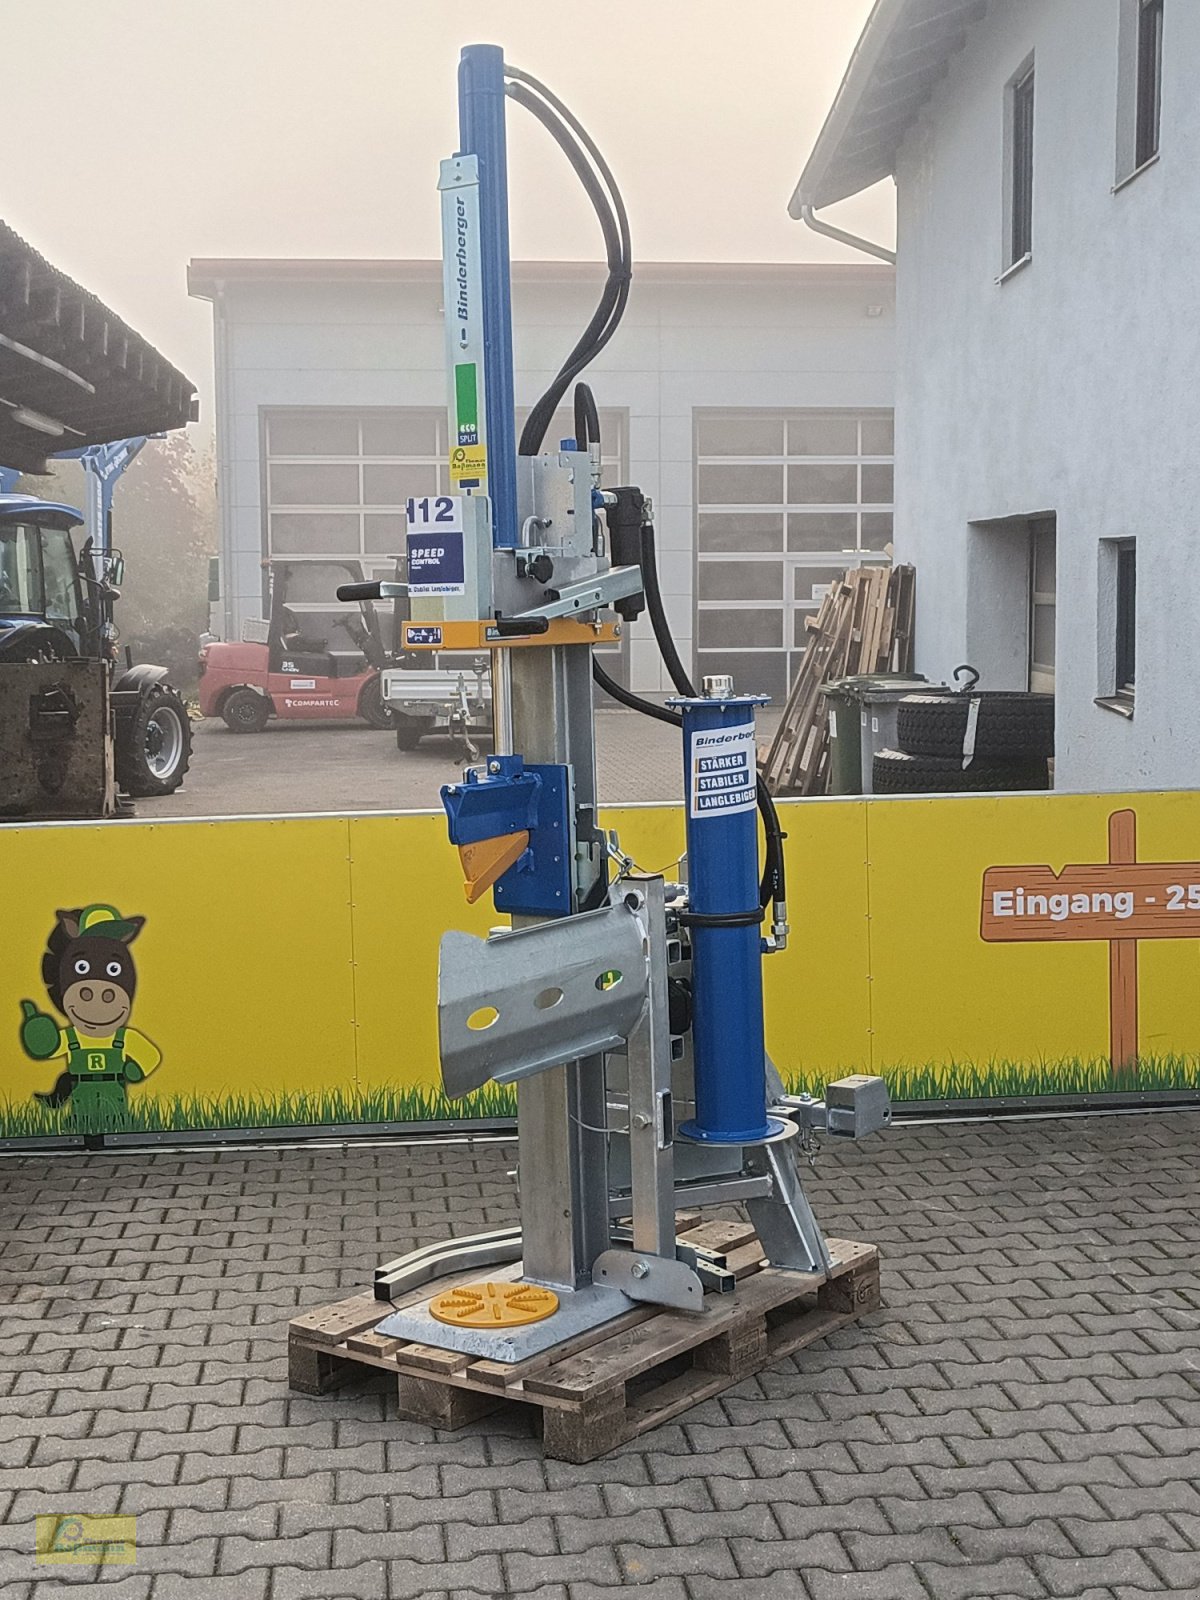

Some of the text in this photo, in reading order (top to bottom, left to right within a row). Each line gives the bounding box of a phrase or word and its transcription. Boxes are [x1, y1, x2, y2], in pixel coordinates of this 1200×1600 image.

[456, 196, 468, 321] Binderberger
[460, 434, 476, 443] SPLIT
[411, 548, 445, 558] SPEED
[701, 755, 744, 770] STÄRKER
[700, 774, 745, 790] STABILER
[992, 887, 1134, 921] Eingang
[90, 1055, 103, 1069] R
